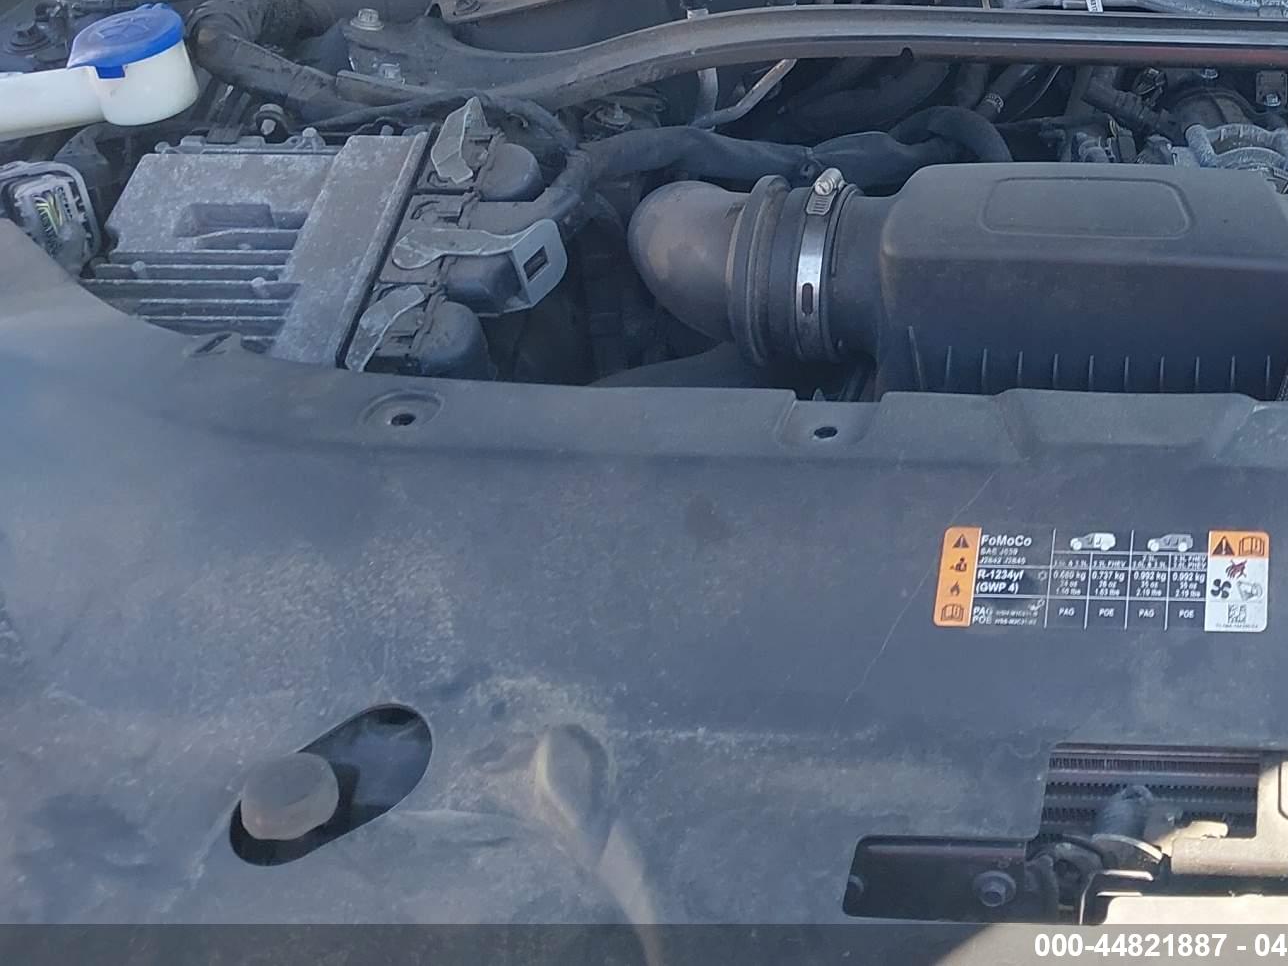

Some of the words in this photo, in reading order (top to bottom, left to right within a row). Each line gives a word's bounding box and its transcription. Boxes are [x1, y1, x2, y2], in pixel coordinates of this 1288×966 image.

[981, 534, 1032, 547] FoMoCo
[977, 569, 1025, 581] R-1234yf
[1076, 570, 1086, 581] kg
[1114, 571, 1125, 582] kg
[1156, 571, 1167, 582] kg
[1195, 572, 1206, 583] kg
[976, 582, 1007, 594] (GWP
[1007, 582, 1019, 594] 4)
[973, 606, 993, 616] PAG
[1058, 607, 1075, 616] PAG
[1098, 607, 1115, 617] POE
[1138, 608, 1155, 618] PAG
[1178, 609, 1195, 618] POE
[972, 615, 993, 625] POE
